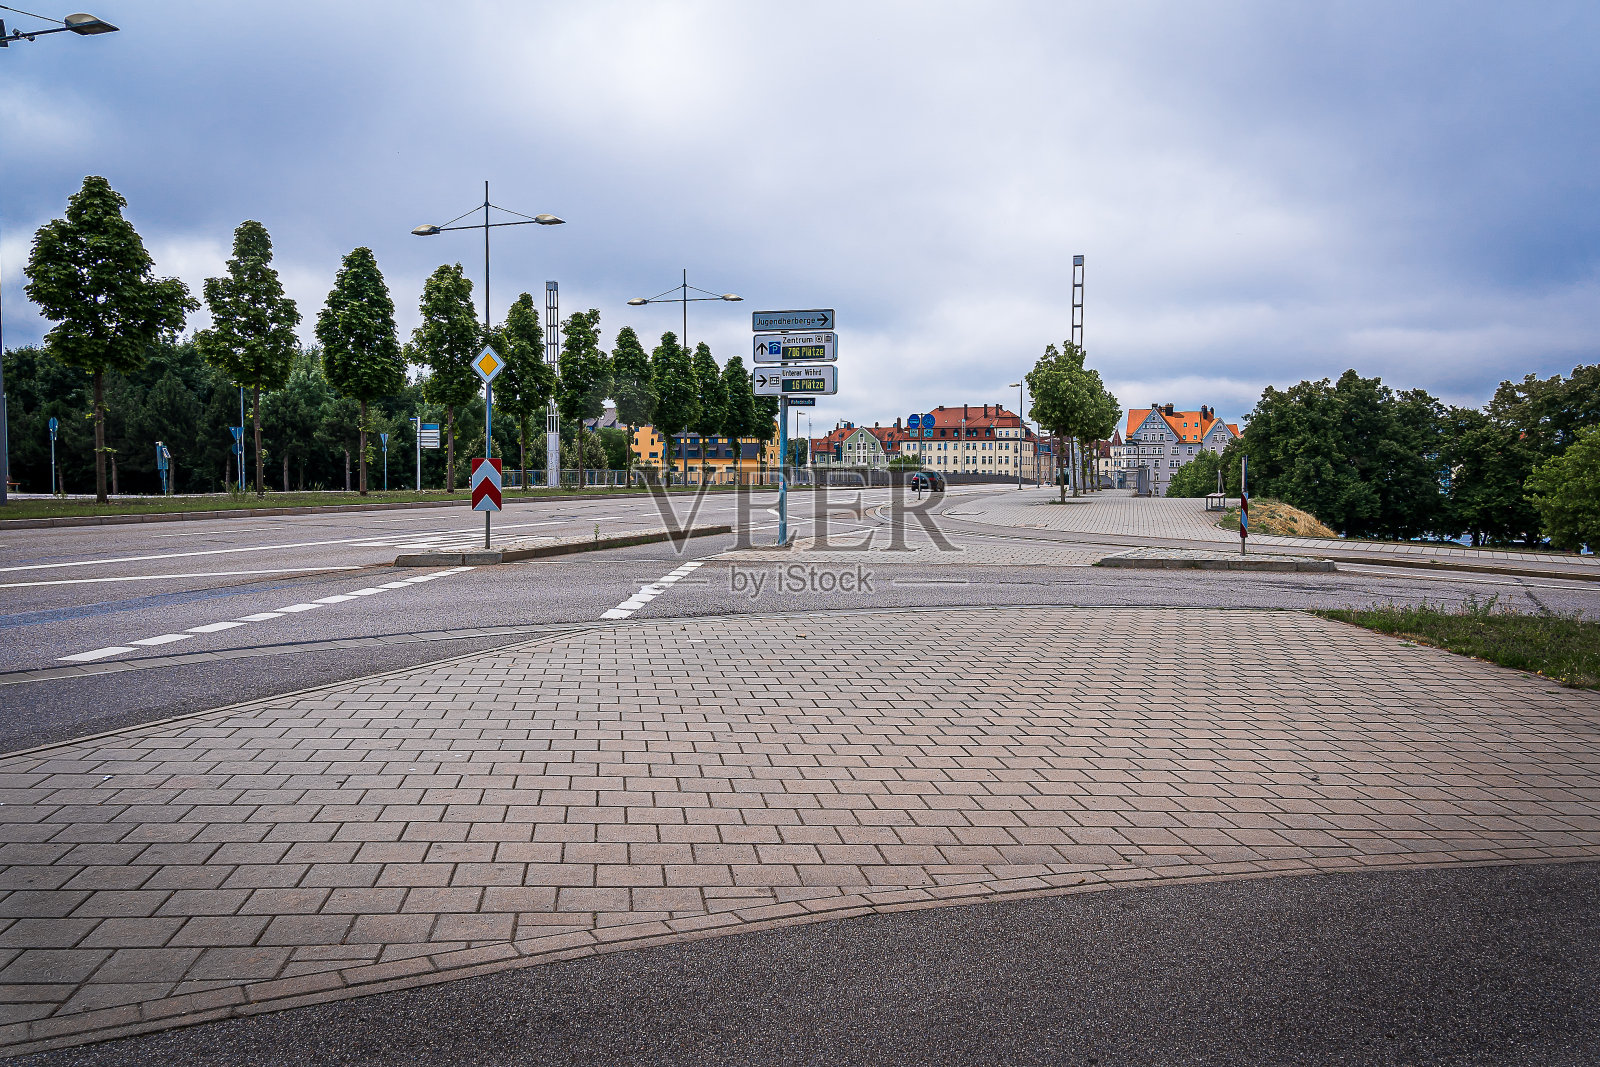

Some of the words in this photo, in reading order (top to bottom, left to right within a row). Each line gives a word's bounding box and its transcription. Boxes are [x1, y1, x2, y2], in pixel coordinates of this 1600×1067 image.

[757, 318, 815, 326] Jugendherberge
[782, 336, 814, 344] Zentrum
[801, 347, 824, 356] Plätze
[782, 369, 802, 377] Unterer
[792, 380, 800, 390] 16
[801, 380, 824, 389] Plätze
